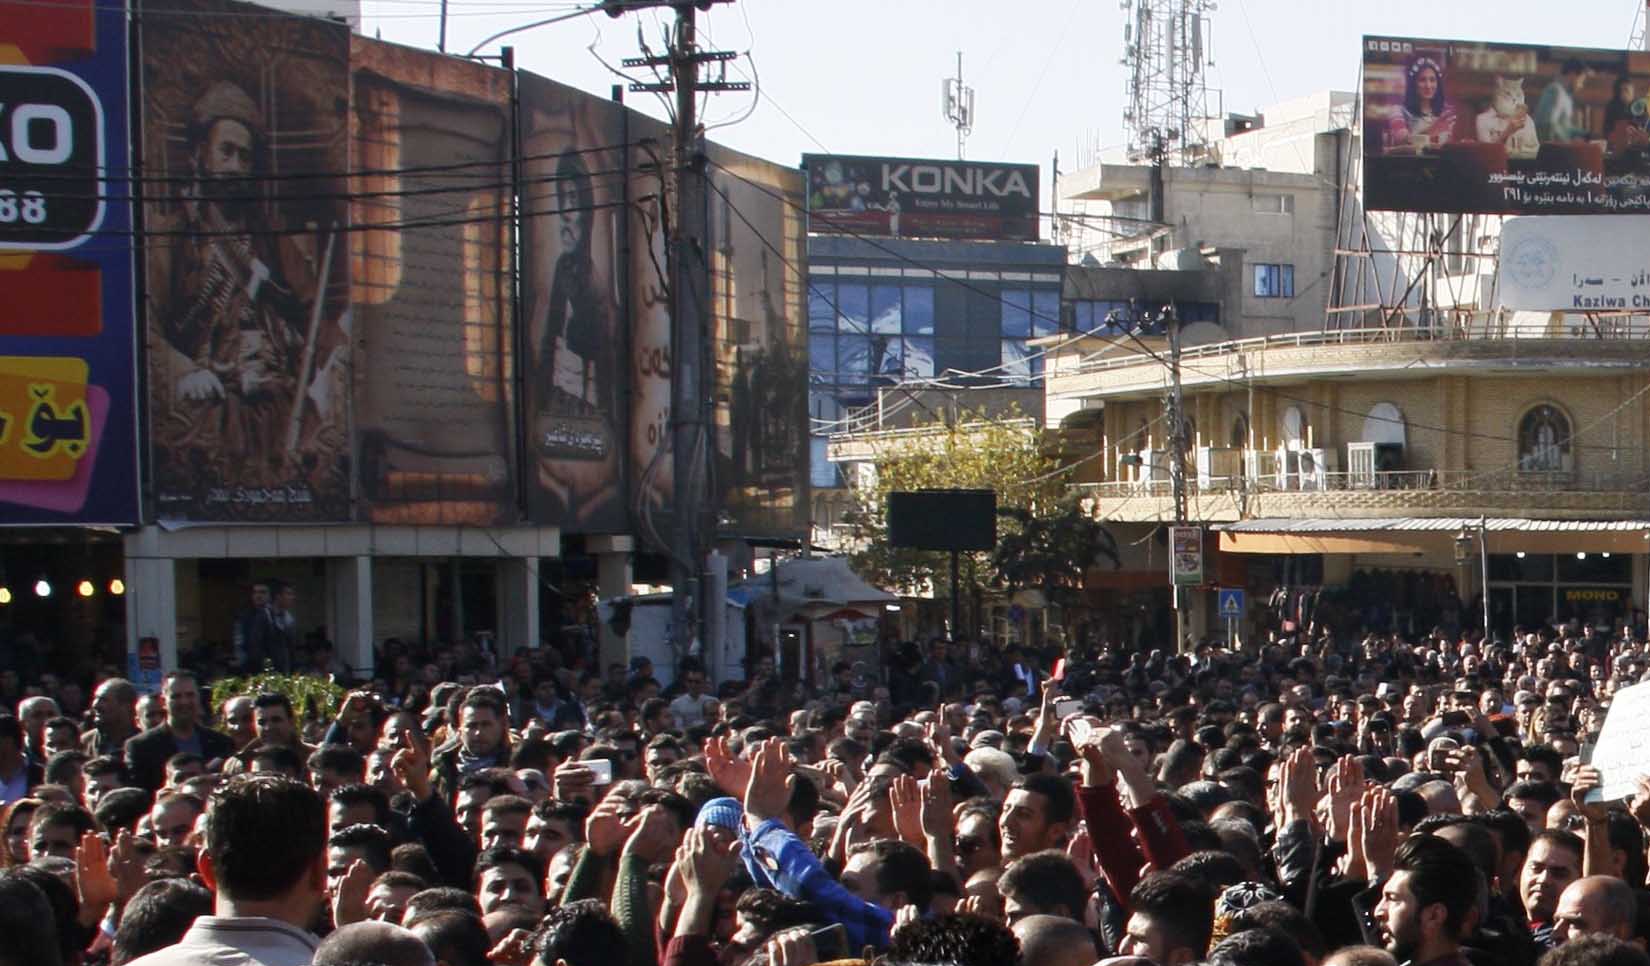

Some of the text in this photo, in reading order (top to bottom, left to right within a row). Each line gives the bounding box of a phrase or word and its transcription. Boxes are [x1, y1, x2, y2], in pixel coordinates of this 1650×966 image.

[0, 103, 73, 165] O
[882, 164, 1032, 198] KONKA
[1573, 295, 1626, 308] Kaziwa
